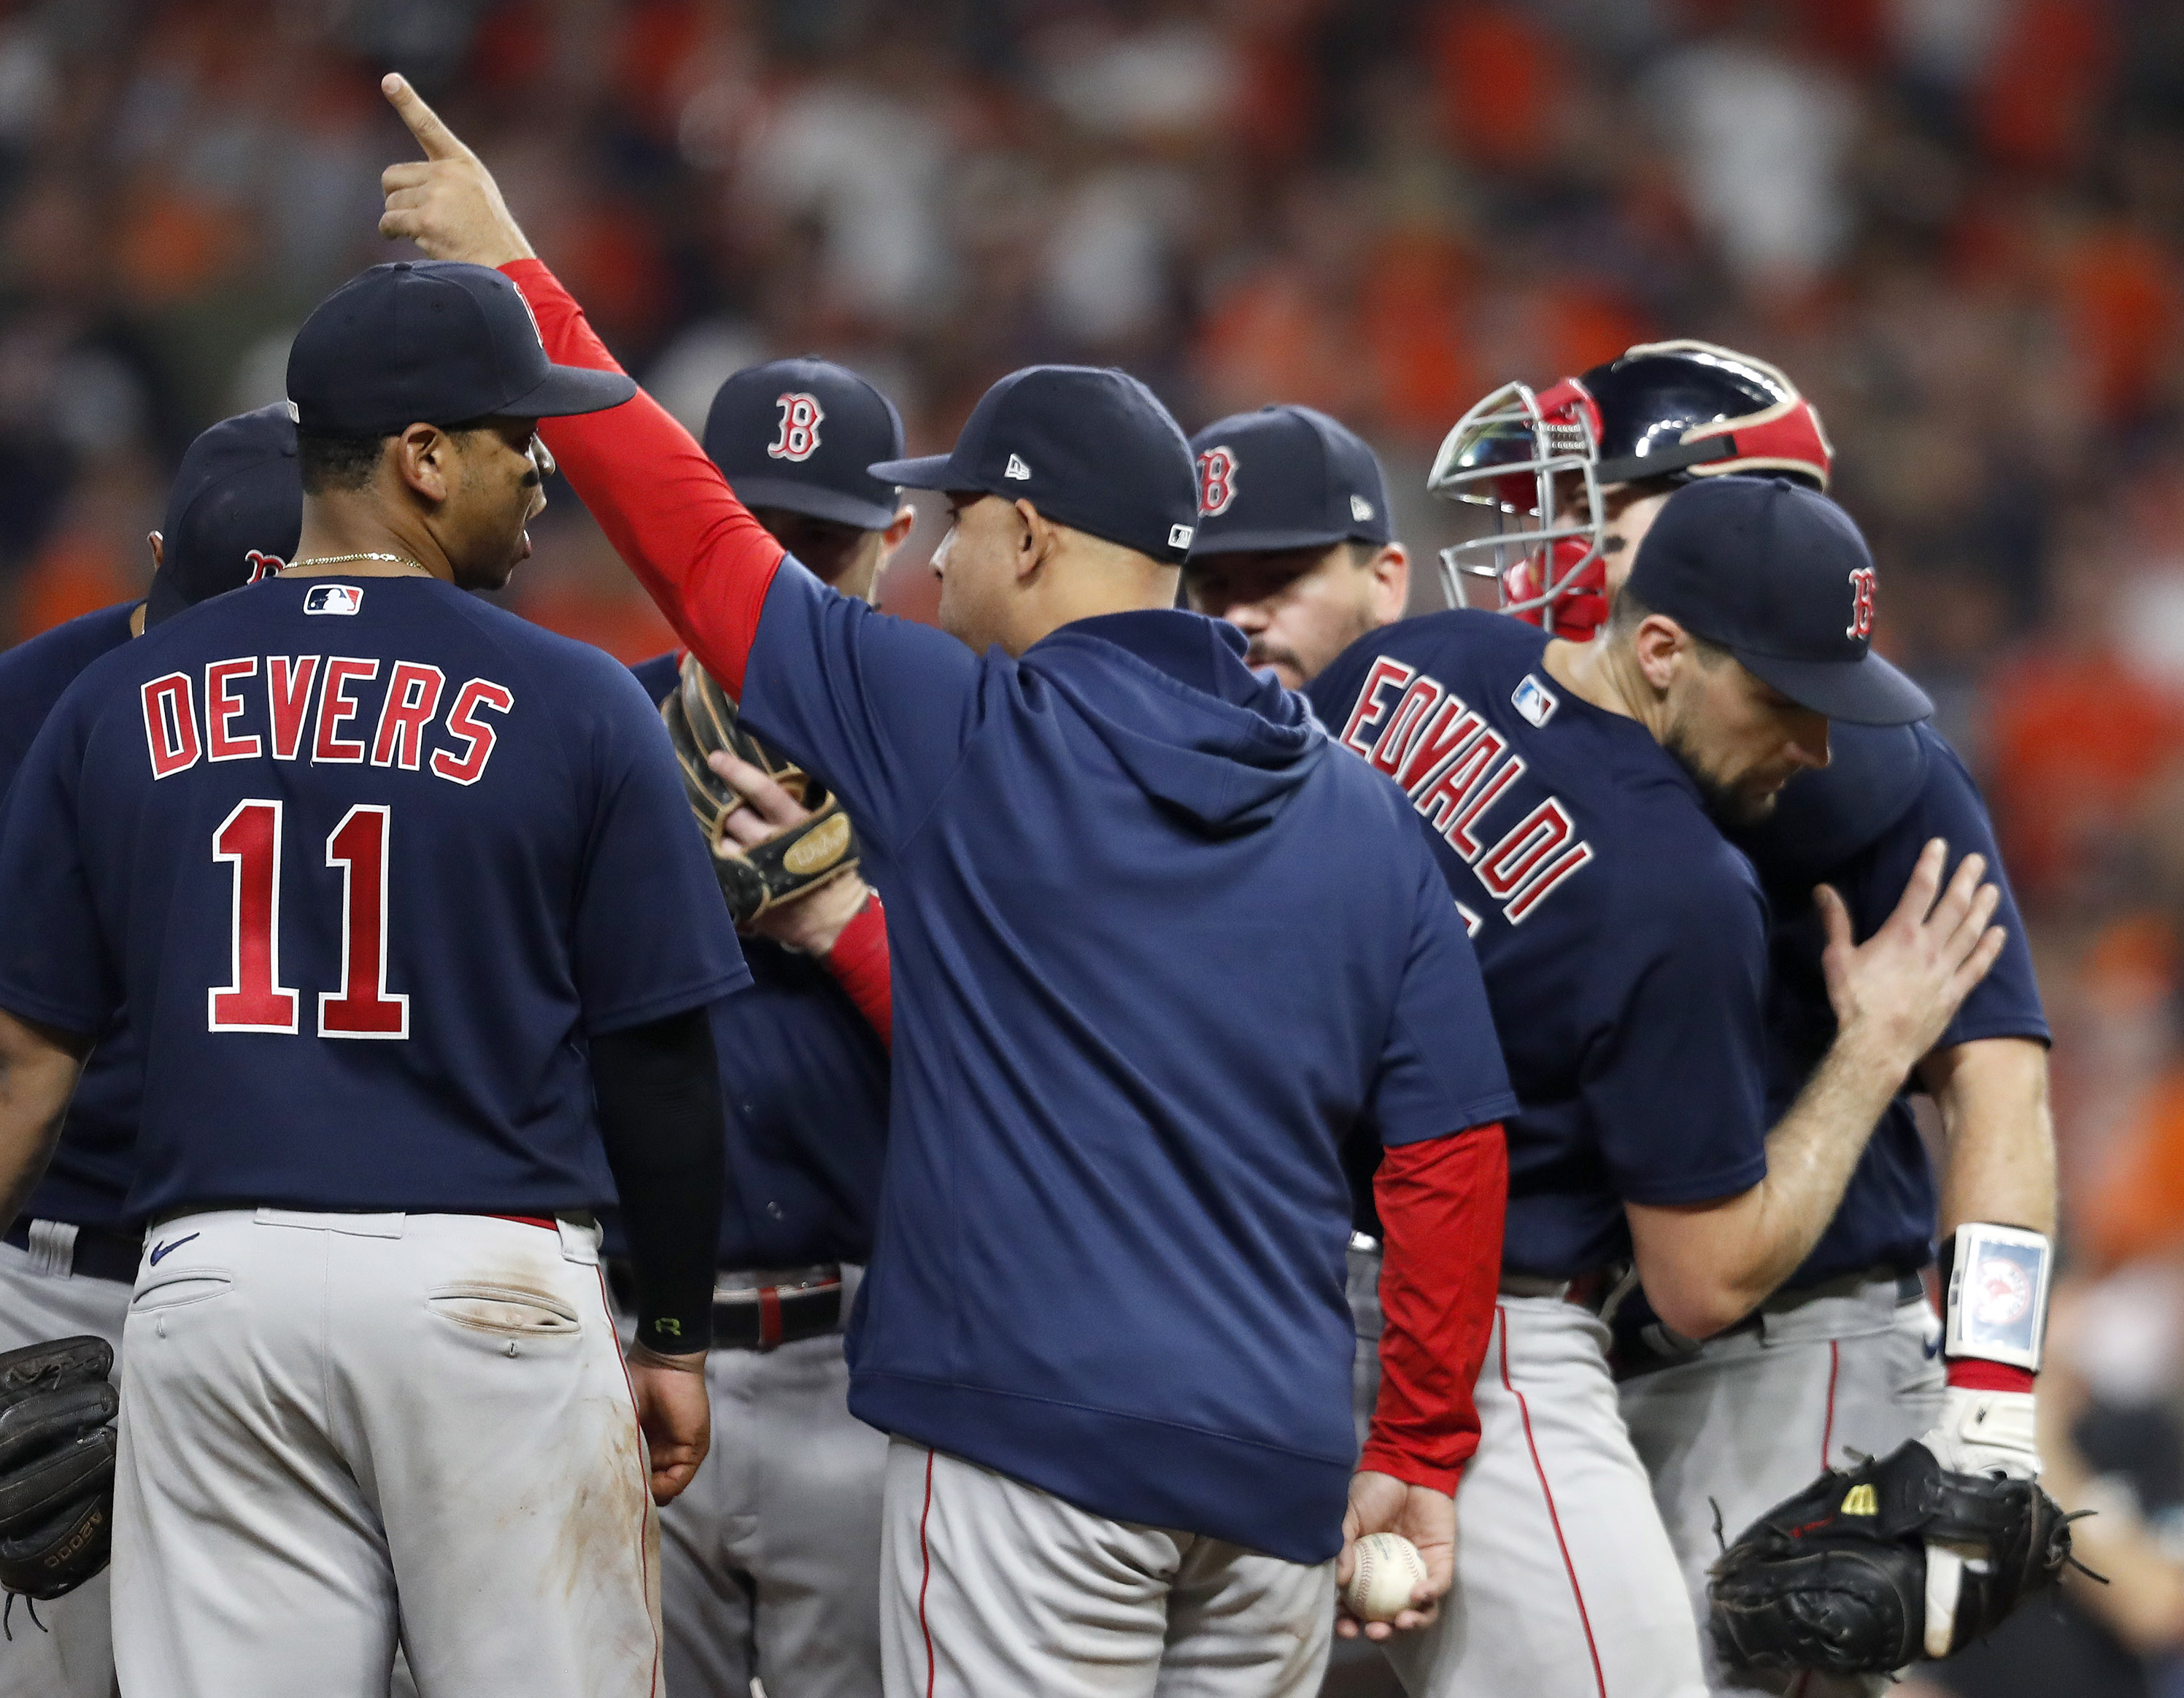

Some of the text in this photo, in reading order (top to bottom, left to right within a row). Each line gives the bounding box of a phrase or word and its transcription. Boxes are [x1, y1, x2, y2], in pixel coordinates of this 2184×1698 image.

[768, 393, 825, 461] B
[1197, 446, 1239, 517] B
[1846, 567, 1876, 641] B
[140, 655, 514, 786] DEVERS
[1340, 655, 1594, 925] EOVALDI
[208, 798, 409, 1040] 11
